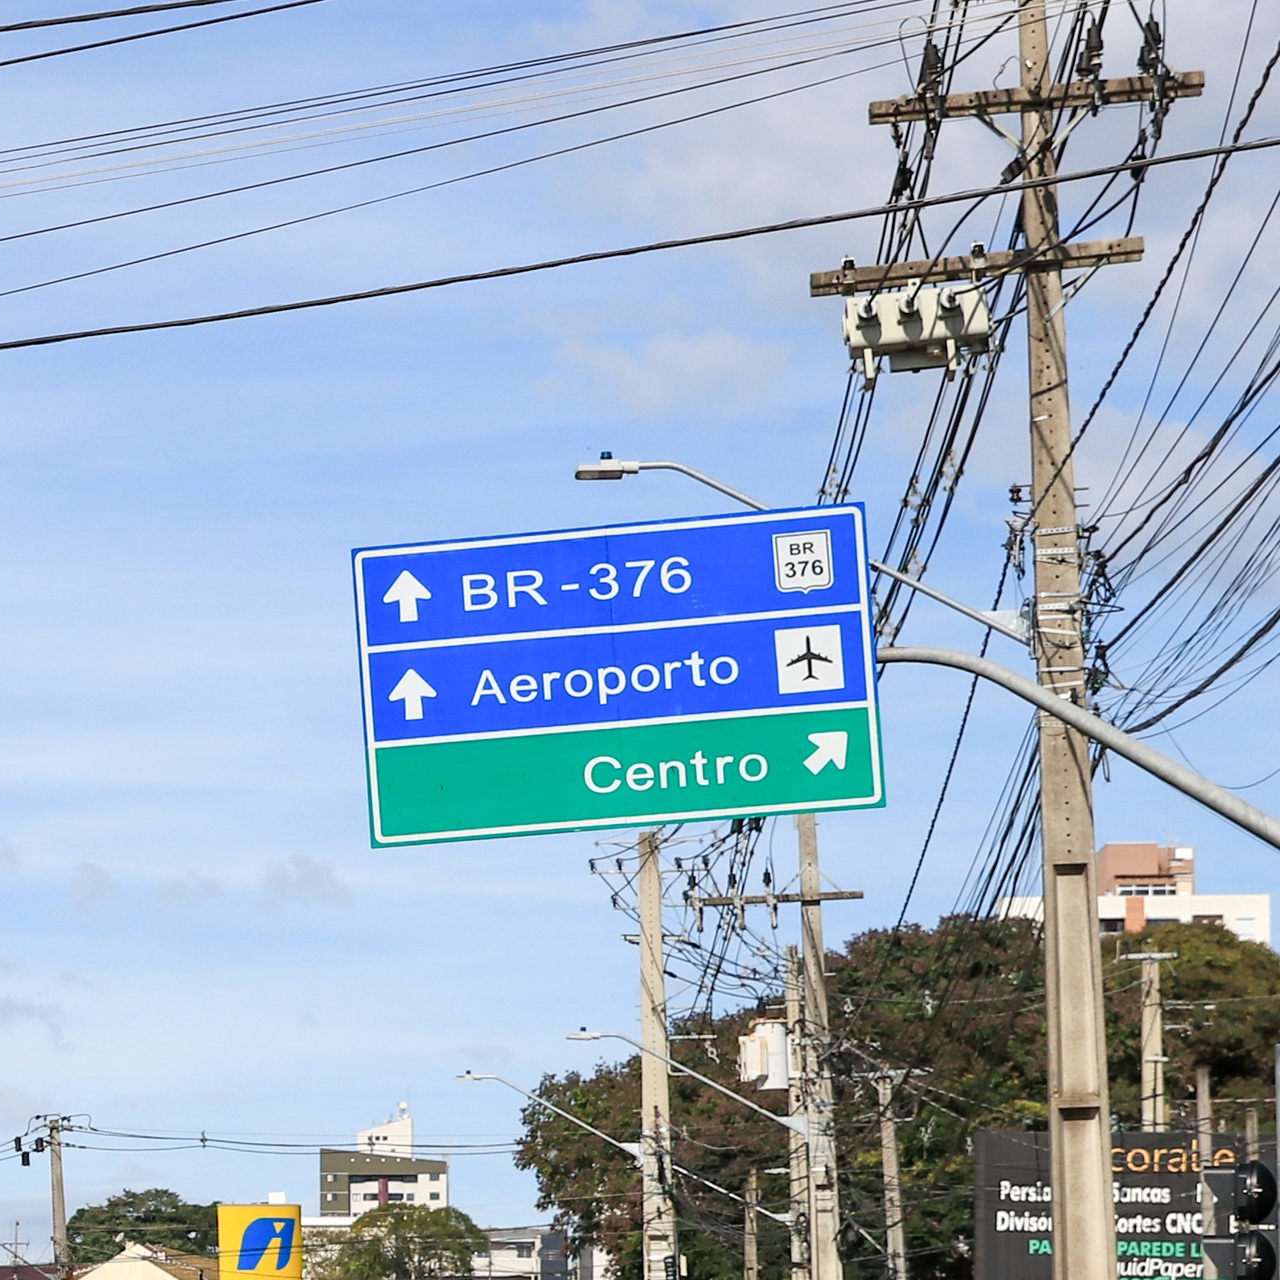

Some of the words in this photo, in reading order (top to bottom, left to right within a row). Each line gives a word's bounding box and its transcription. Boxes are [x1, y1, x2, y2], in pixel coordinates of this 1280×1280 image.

[788, 542, 816, 557] BR
[783, 559, 825, 579] 376
[470, 649, 740, 706] Aeroporto
[583, 748, 770, 794] Centro
[1165, 1212, 1203, 1235] CNC
[1117, 1241, 1186, 1258] PAREDE
